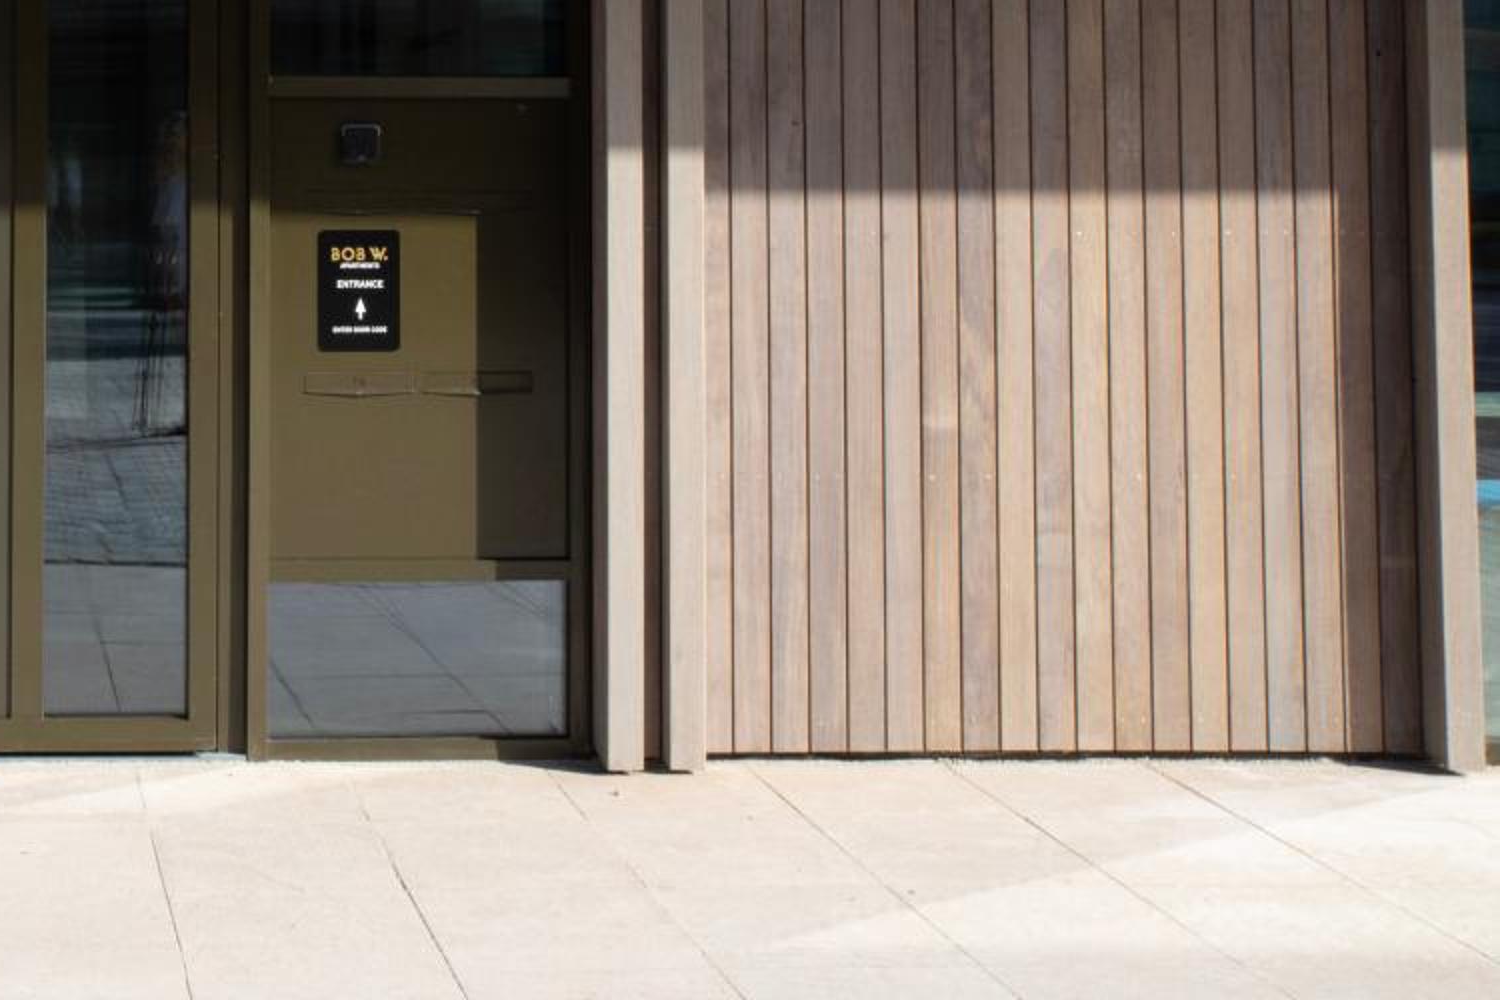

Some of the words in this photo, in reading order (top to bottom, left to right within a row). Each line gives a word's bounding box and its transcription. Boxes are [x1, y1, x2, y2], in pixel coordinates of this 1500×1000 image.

[331, 247, 366, 261] BOB
[369, 247, 389, 261] W.
[336, 279, 384, 289] ENTRANCE
